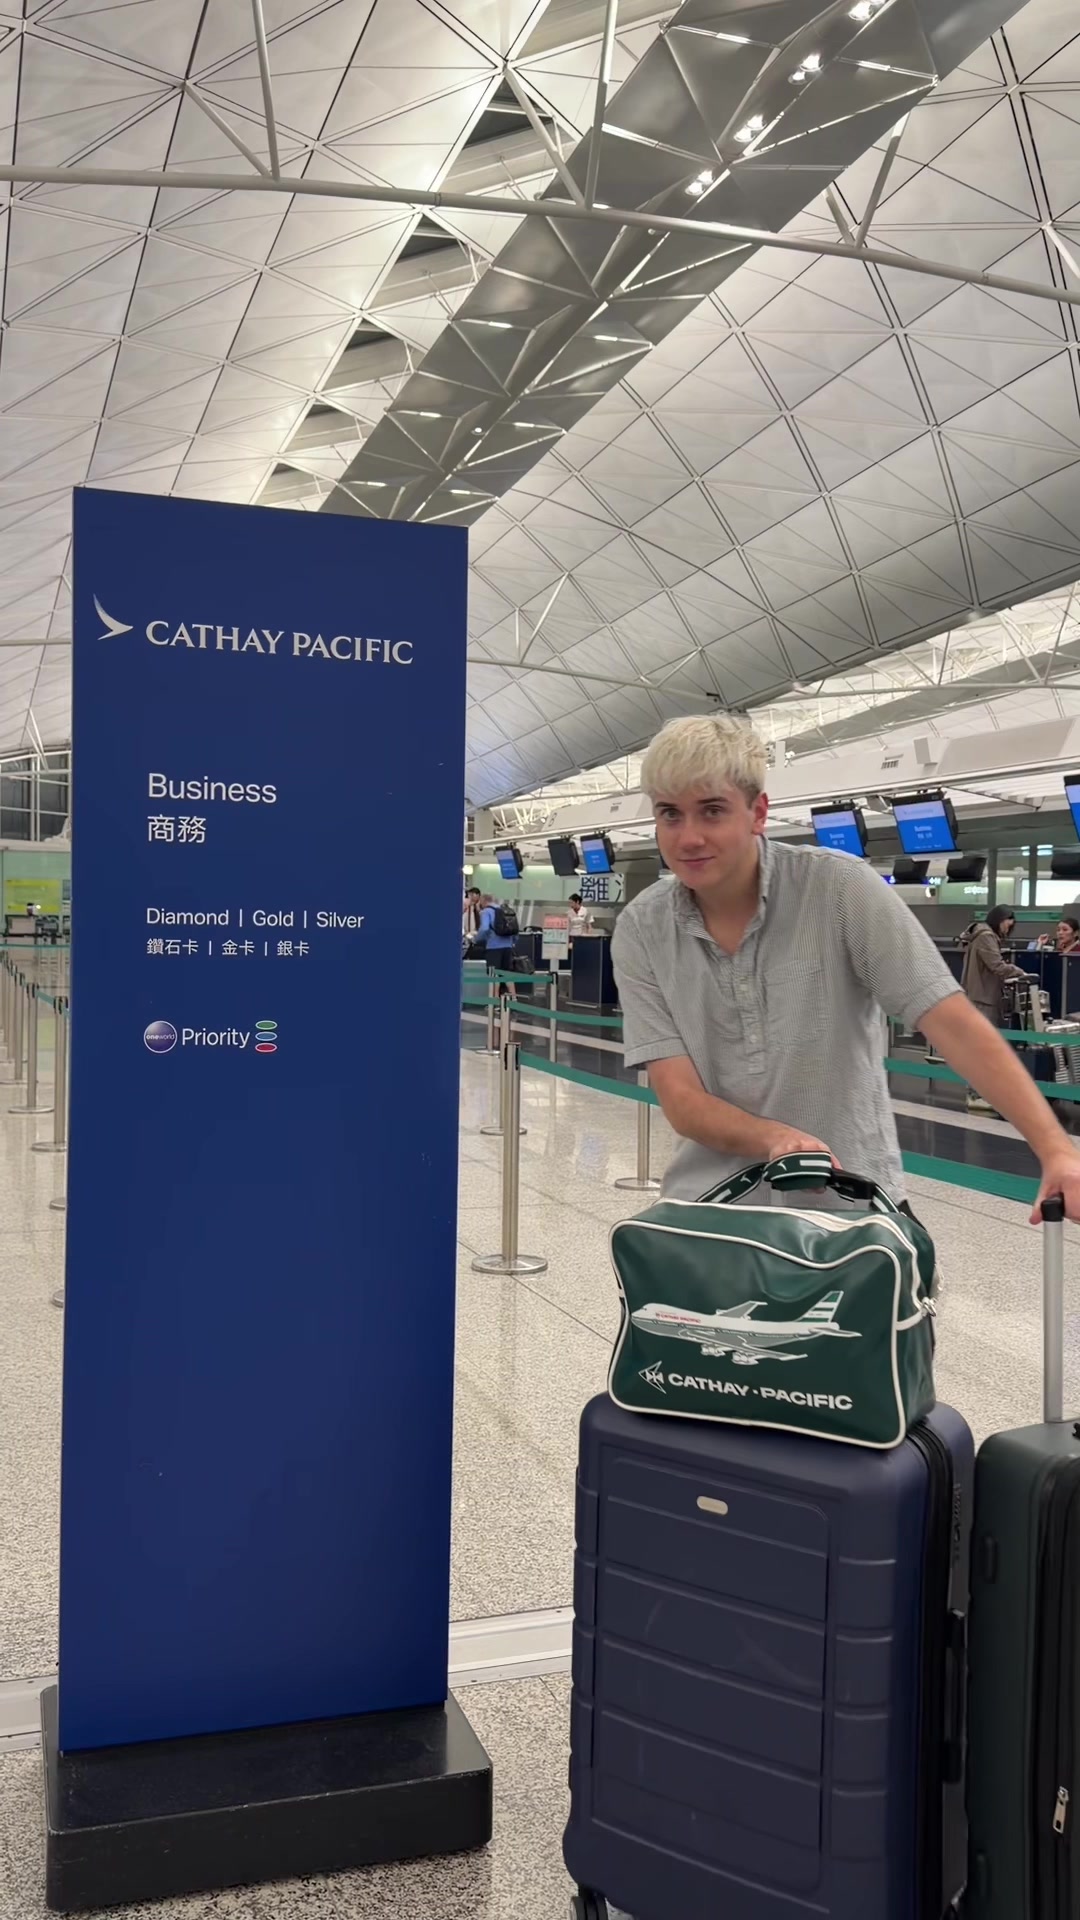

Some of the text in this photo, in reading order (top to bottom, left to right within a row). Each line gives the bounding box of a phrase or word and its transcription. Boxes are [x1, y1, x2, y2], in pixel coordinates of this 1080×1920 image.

[145, 620, 413, 665] CATHAY PACIFIC
[148, 772, 277, 804] Business
[147, 813, 207, 844] 商務
[146, 907, 229, 926] Diamond
[252, 909, 294, 927] Gold
[316, 911, 365, 929] Silver
[146, 938, 199, 955] 鑽石卡
[221, 939, 255, 956] 金卡
[277, 940, 310, 957] 銀卡
[182, 1027, 251, 1049] Priority
[668, 1373, 749, 1396] CATHAY
[760, 1387, 853, 1410] PACIFIC
